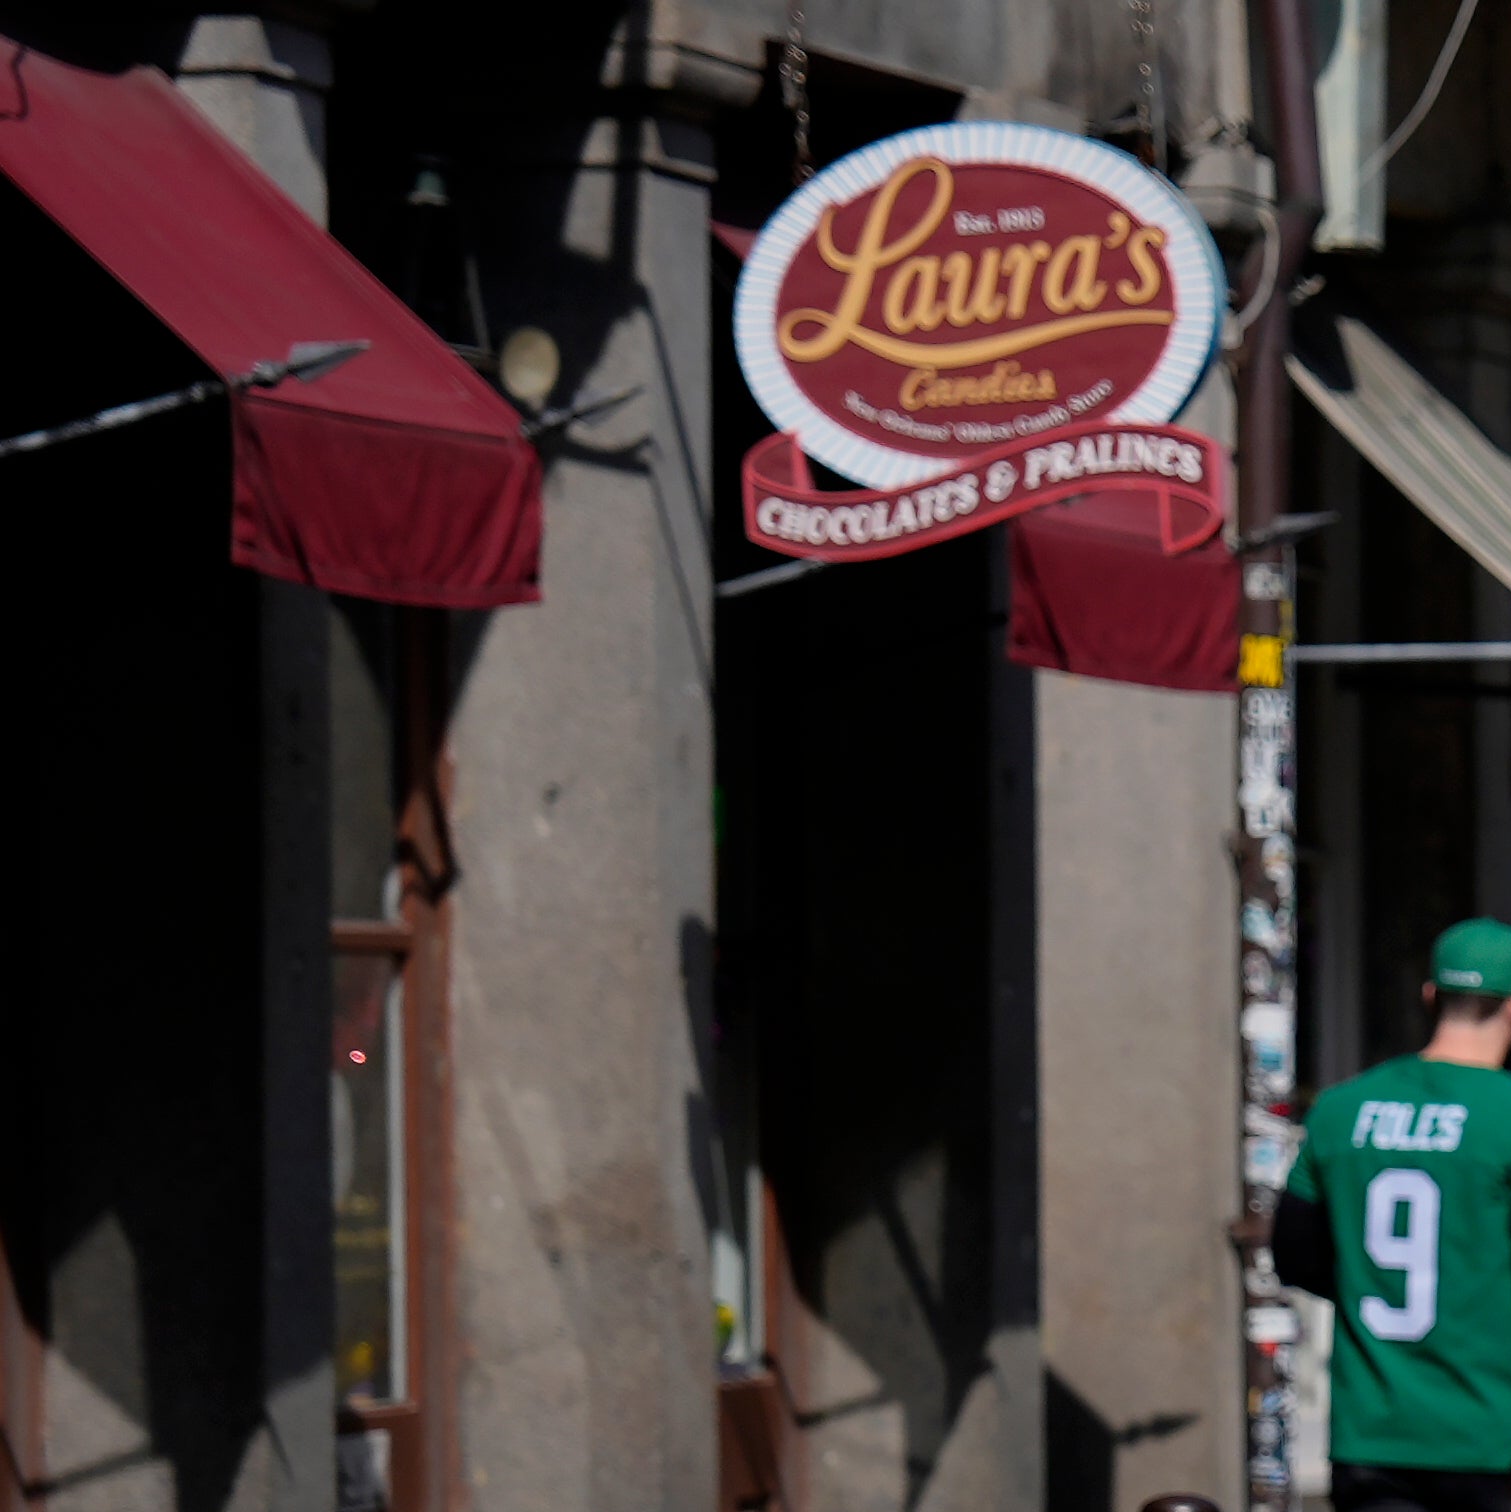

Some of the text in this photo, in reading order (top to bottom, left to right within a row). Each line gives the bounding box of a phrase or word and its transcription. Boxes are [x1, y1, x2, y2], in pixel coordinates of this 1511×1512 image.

[777, 156, 1174, 368] Laura's
[899, 362, 1057, 411] Candies
[756, 432, 1204, 544] CHOCOLATES & PRALINES
[1352, 1100, 1468, 1152] FOLES
[1359, 1167, 1441, 1342] 9
